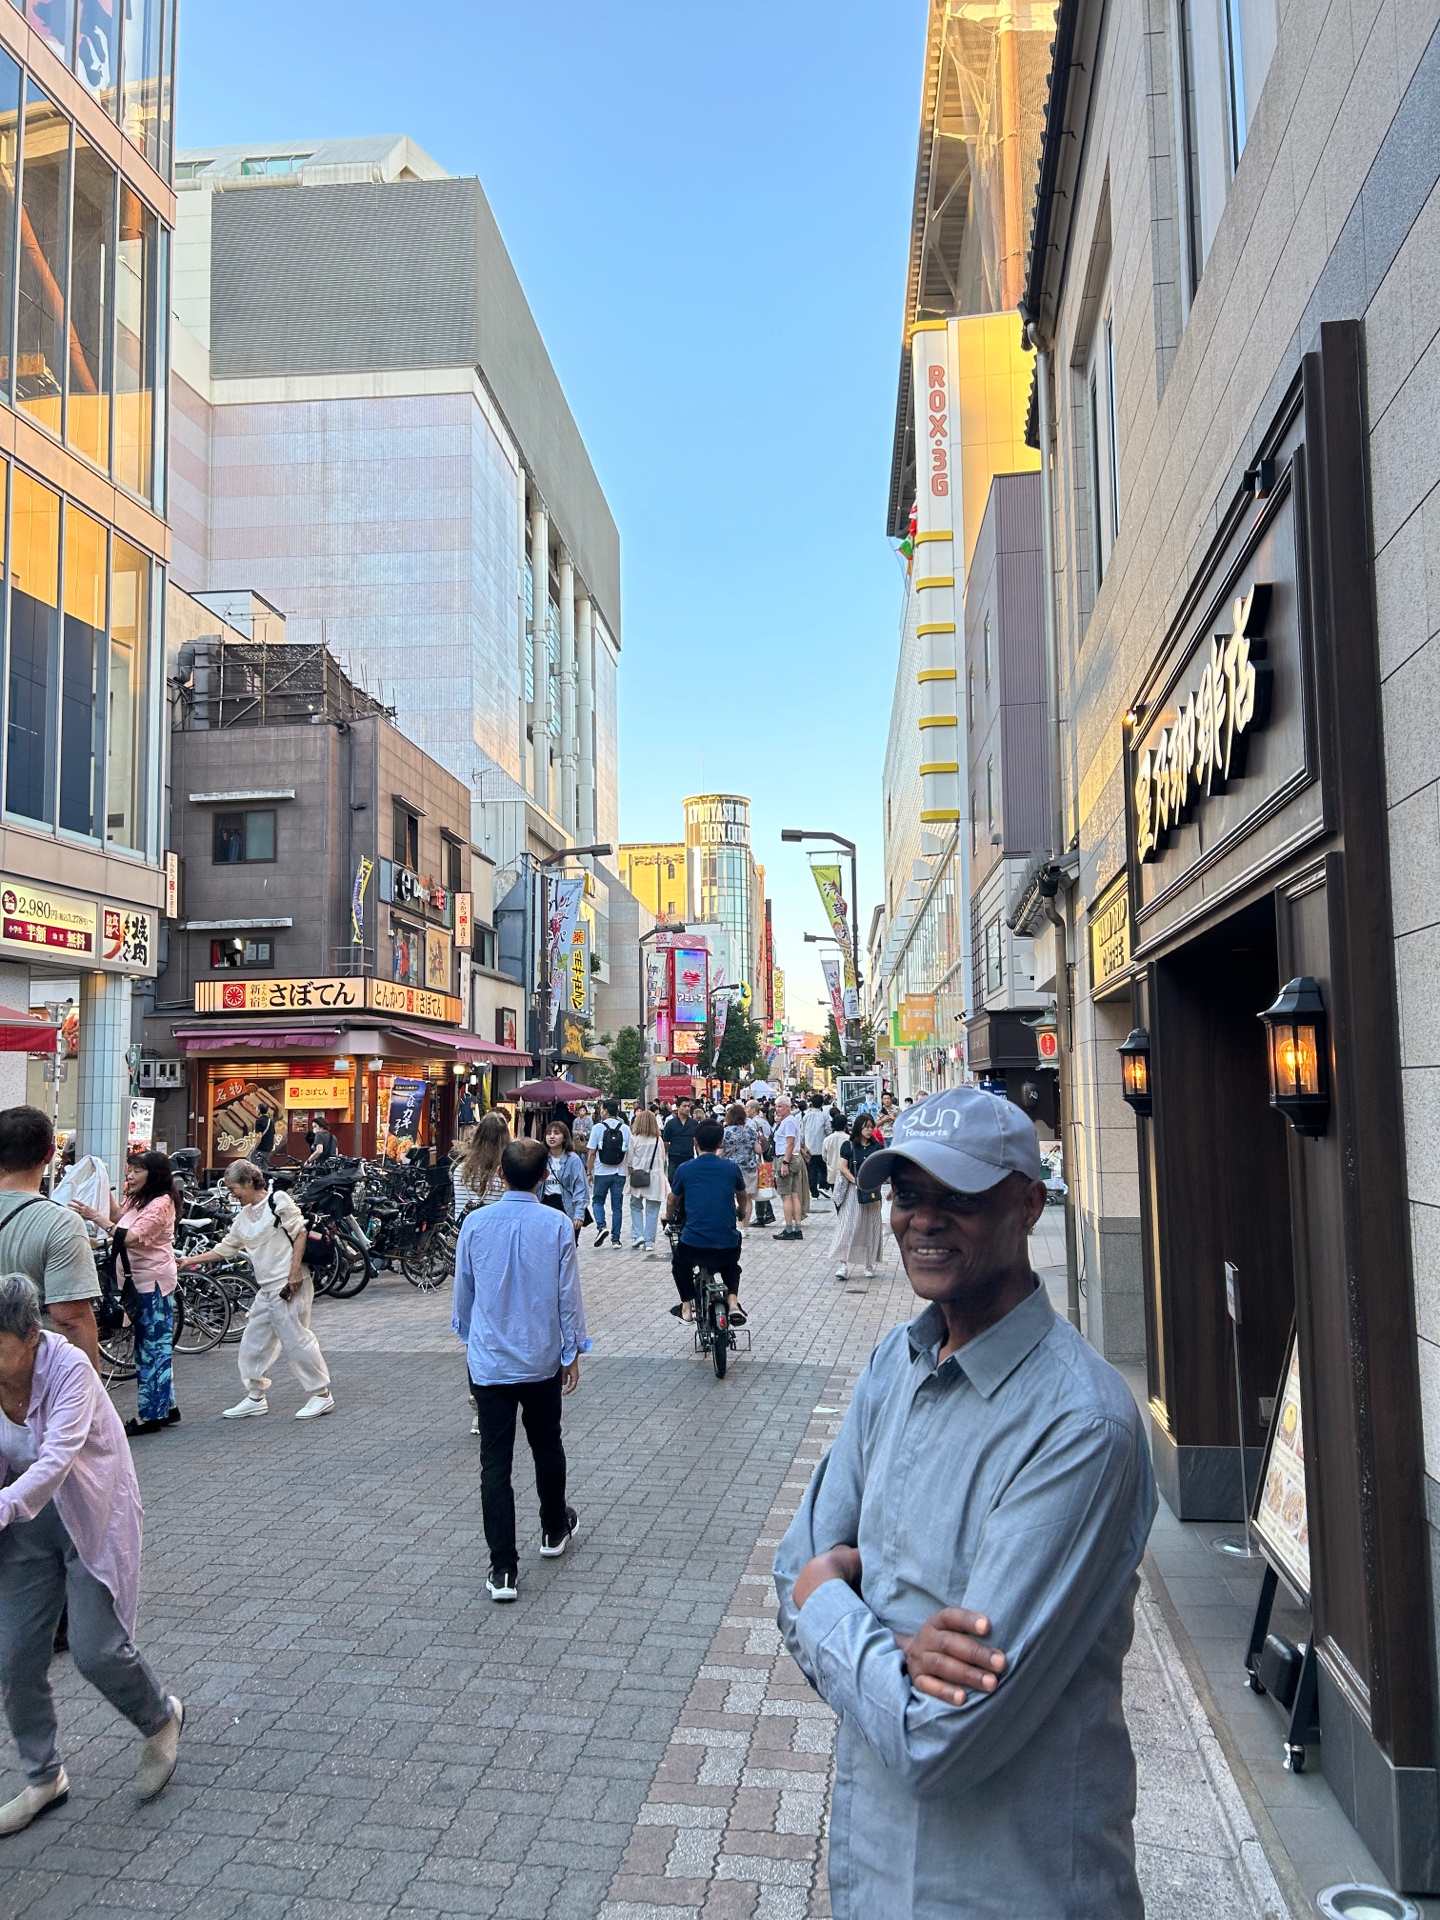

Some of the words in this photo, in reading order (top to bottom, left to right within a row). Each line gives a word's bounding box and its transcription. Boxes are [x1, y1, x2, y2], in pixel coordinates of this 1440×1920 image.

[1135, 583, 1257, 865] 星乃珈琲店
[18, 896, 58, 921] 2,980円
[26, 923, 47, 944] 半額
[66, 931, 86, 950] 無料
[132, 915, 149, 966] 焼肉
[571, 930, 585, 944] 薬
[248, 946, 268, 959] 2F
[571, 950, 585, 1011] マツモトキヨシ
[249, 983, 261, 1008] 新宿
[269, 981, 356, 1008] さぼてん
[374, 983, 406, 1009] とんかつ
[419, 992, 443, 1018] さぼてん
[677, 993, 706, 1002] アミューズ
[216, 1081, 243, 1102] 名物
[305, 1088, 329, 1096] さぼてん
[905, 1129, 949, 1138] Resorts
